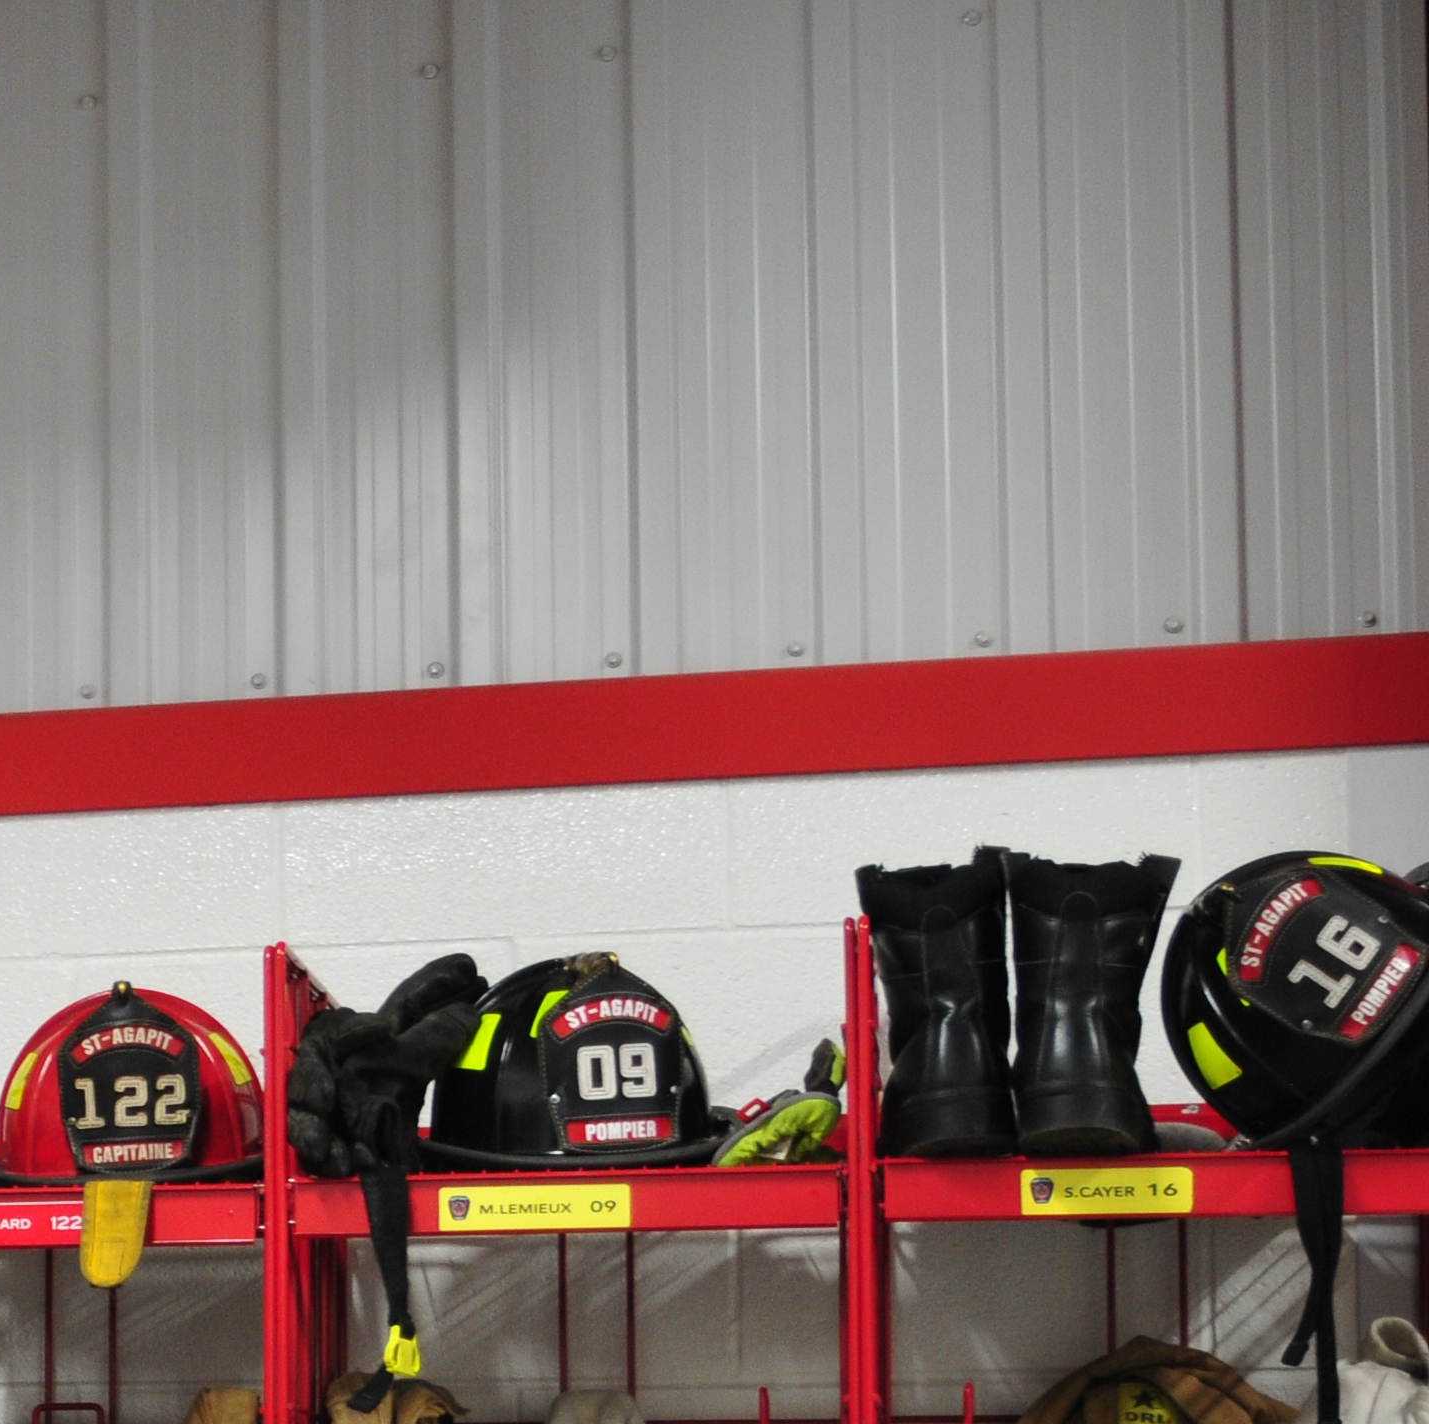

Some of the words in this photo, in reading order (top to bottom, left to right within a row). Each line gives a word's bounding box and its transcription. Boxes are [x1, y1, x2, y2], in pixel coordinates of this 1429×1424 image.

[1241, 882, 1308, 968] ST-AGAPIT
[1287, 915, 1381, 1009] 16
[1350, 956, 1411, 1026] POMPIER
[564, 998, 659, 1029] ST-AGAPIT
[80, 1026, 173, 1056] ST-AGAPIT
[577, 1042, 657, 1100] 09
[74, 1073, 189, 1130] 122
[585, 1120, 657, 1142] POMPIER
[92, 1143, 175, 1164] CAPITAINE
[1064, 1186, 1136, 1198] S.CAYER
[1147, 1183, 1178, 1197] 16
[479, 1202, 572, 1215] M.LEMIEUX
[590, 1200, 617, 1213] 09
[50, 1215, 83, 1231] 122
